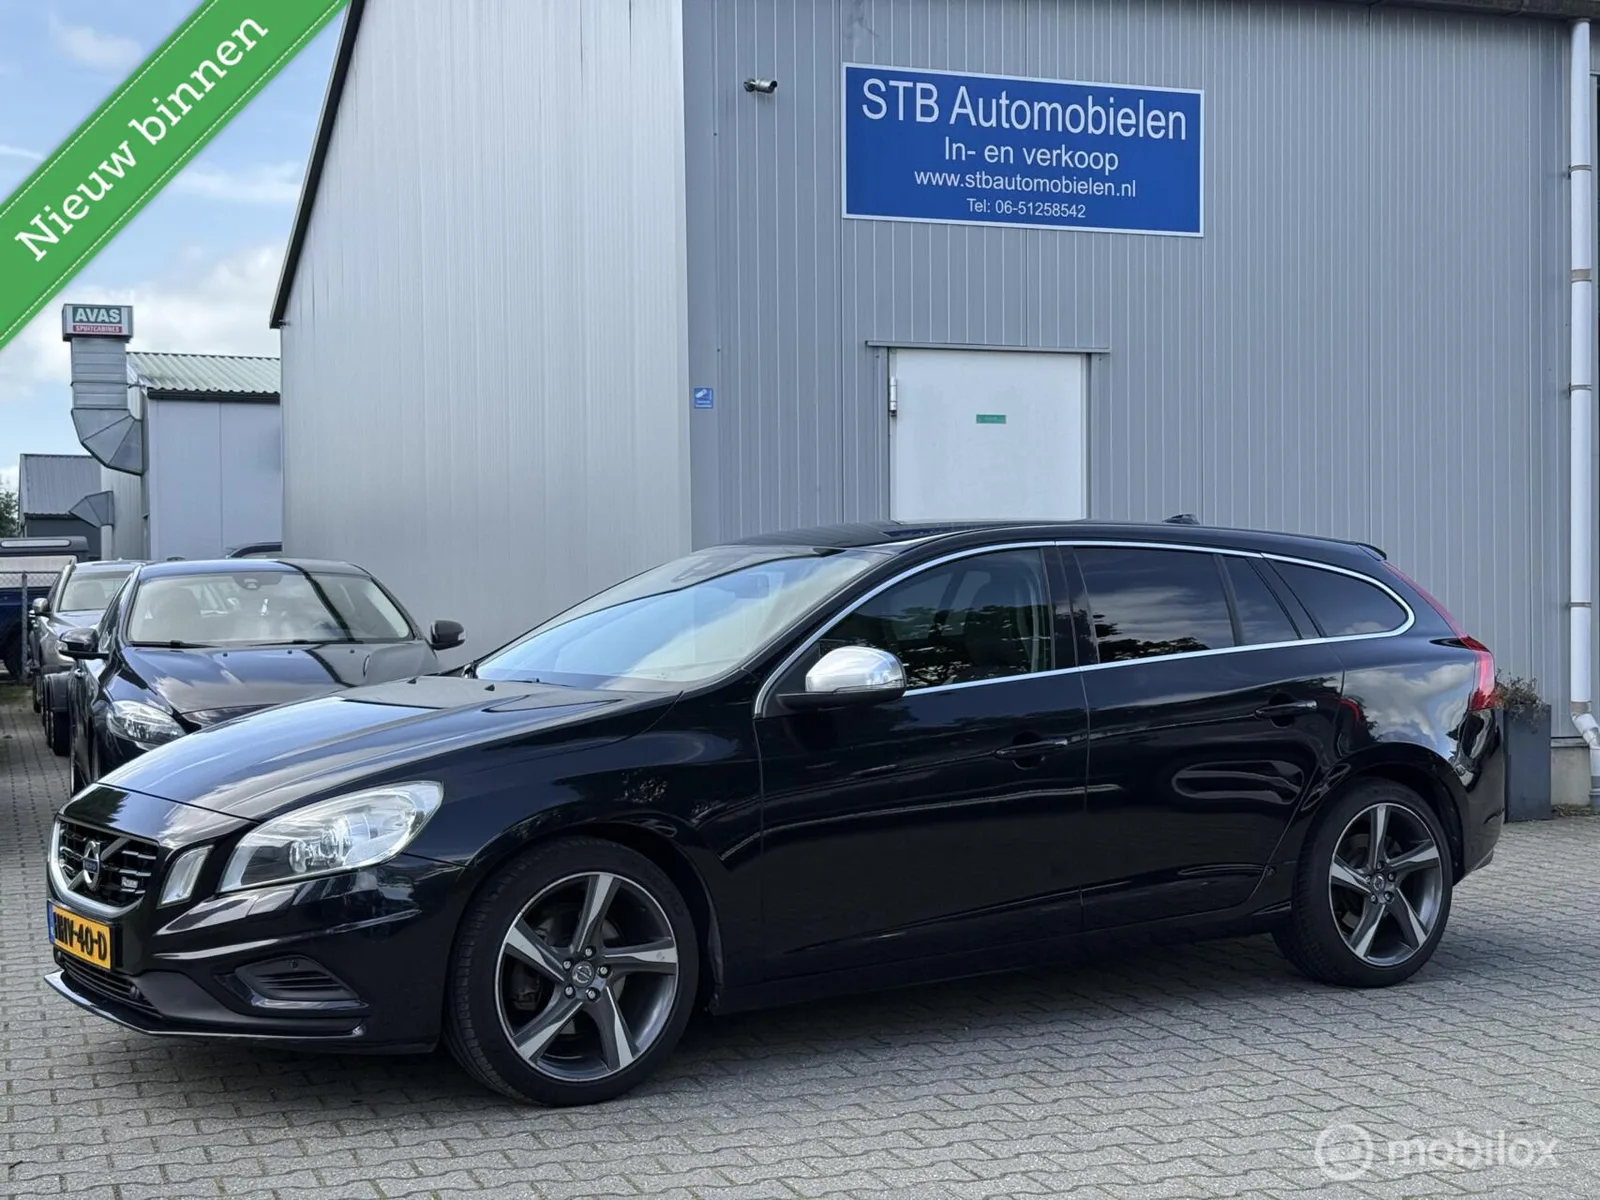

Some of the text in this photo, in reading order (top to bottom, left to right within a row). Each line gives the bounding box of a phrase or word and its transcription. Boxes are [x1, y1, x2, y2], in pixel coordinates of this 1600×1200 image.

[861, 77, 1187, 141] STB Automobielen
[944, 136, 1119, 176] In- en verkoop
[914, 171, 1137, 198] www.stbautomobielen.nl
[966, 197, 1086, 219] Tel: 06-51258542
[74, 307, 120, 323] AVAS
